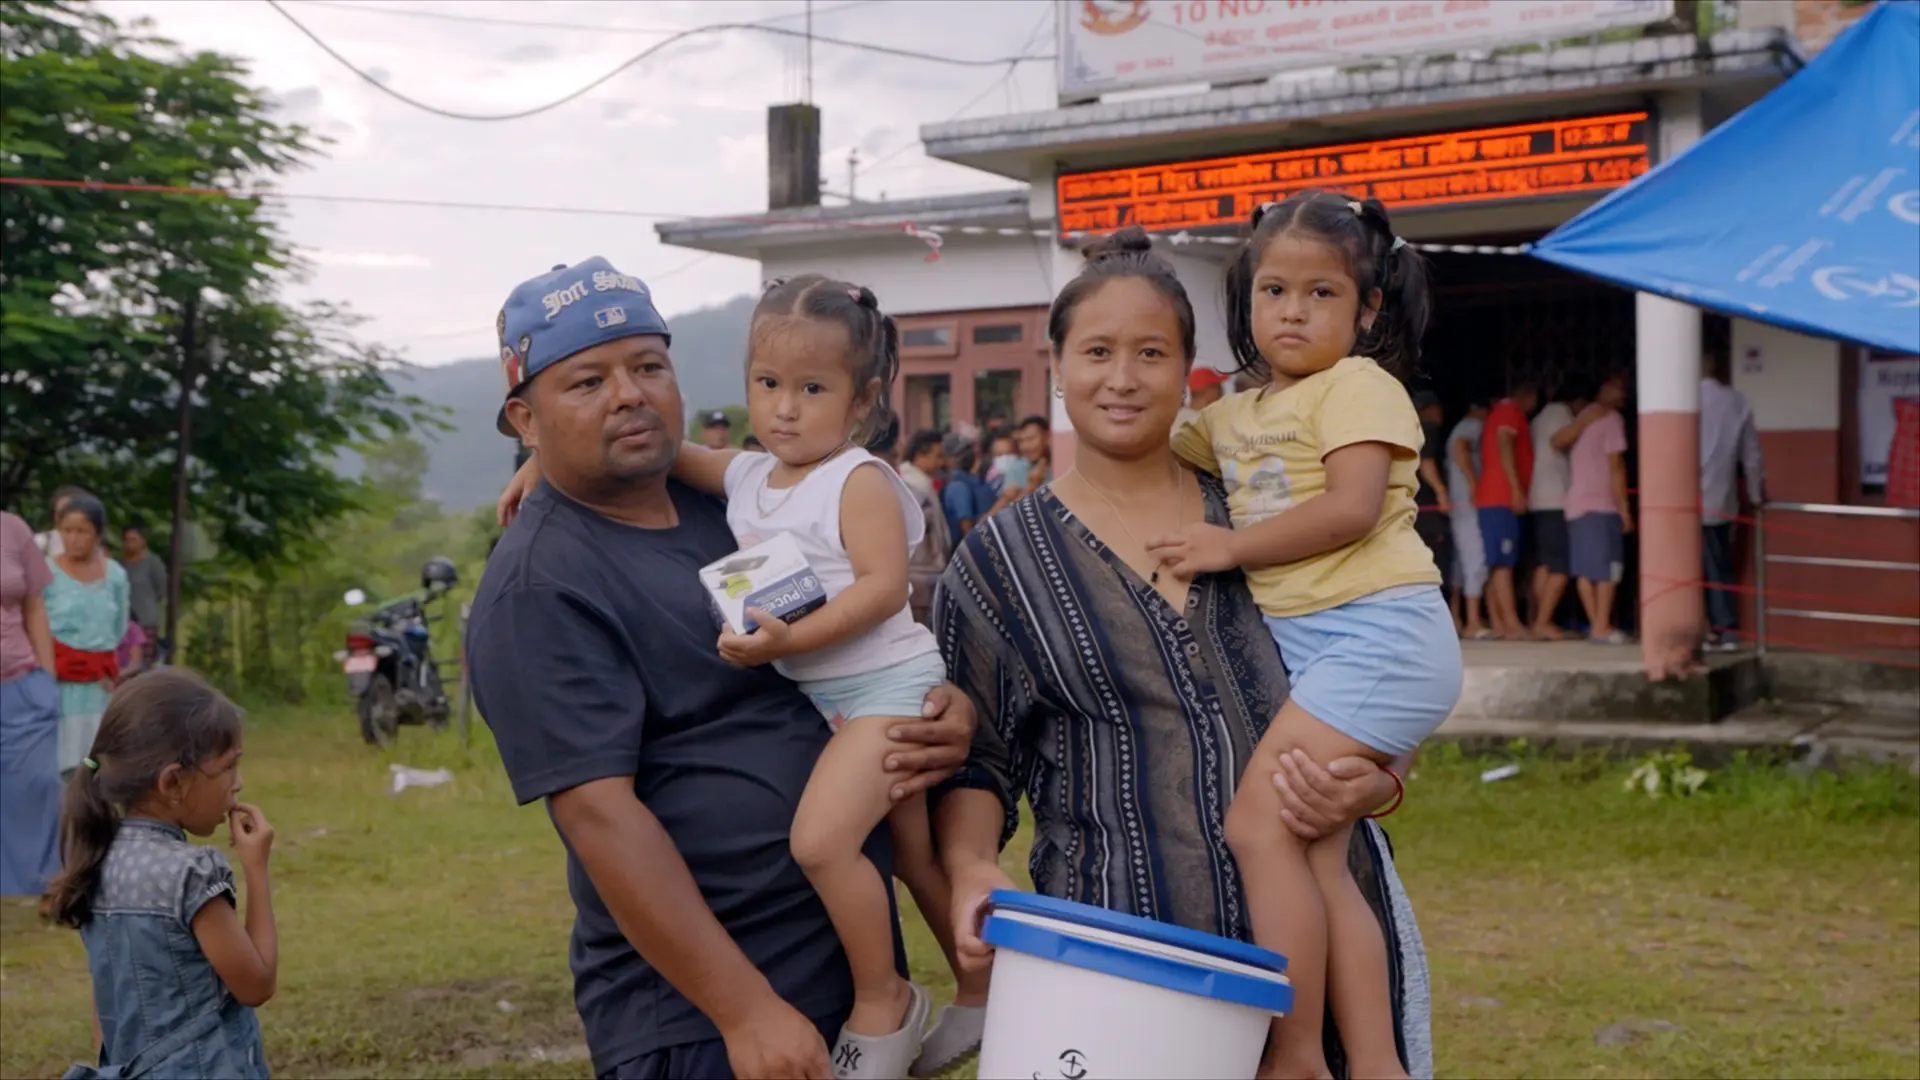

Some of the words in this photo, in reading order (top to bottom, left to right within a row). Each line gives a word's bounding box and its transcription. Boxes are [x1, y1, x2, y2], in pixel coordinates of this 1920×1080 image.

[1172, 2, 1206, 25] 10
[1218, 0, 1271, 19] NO.
[542, 280, 589, 321] Jon
